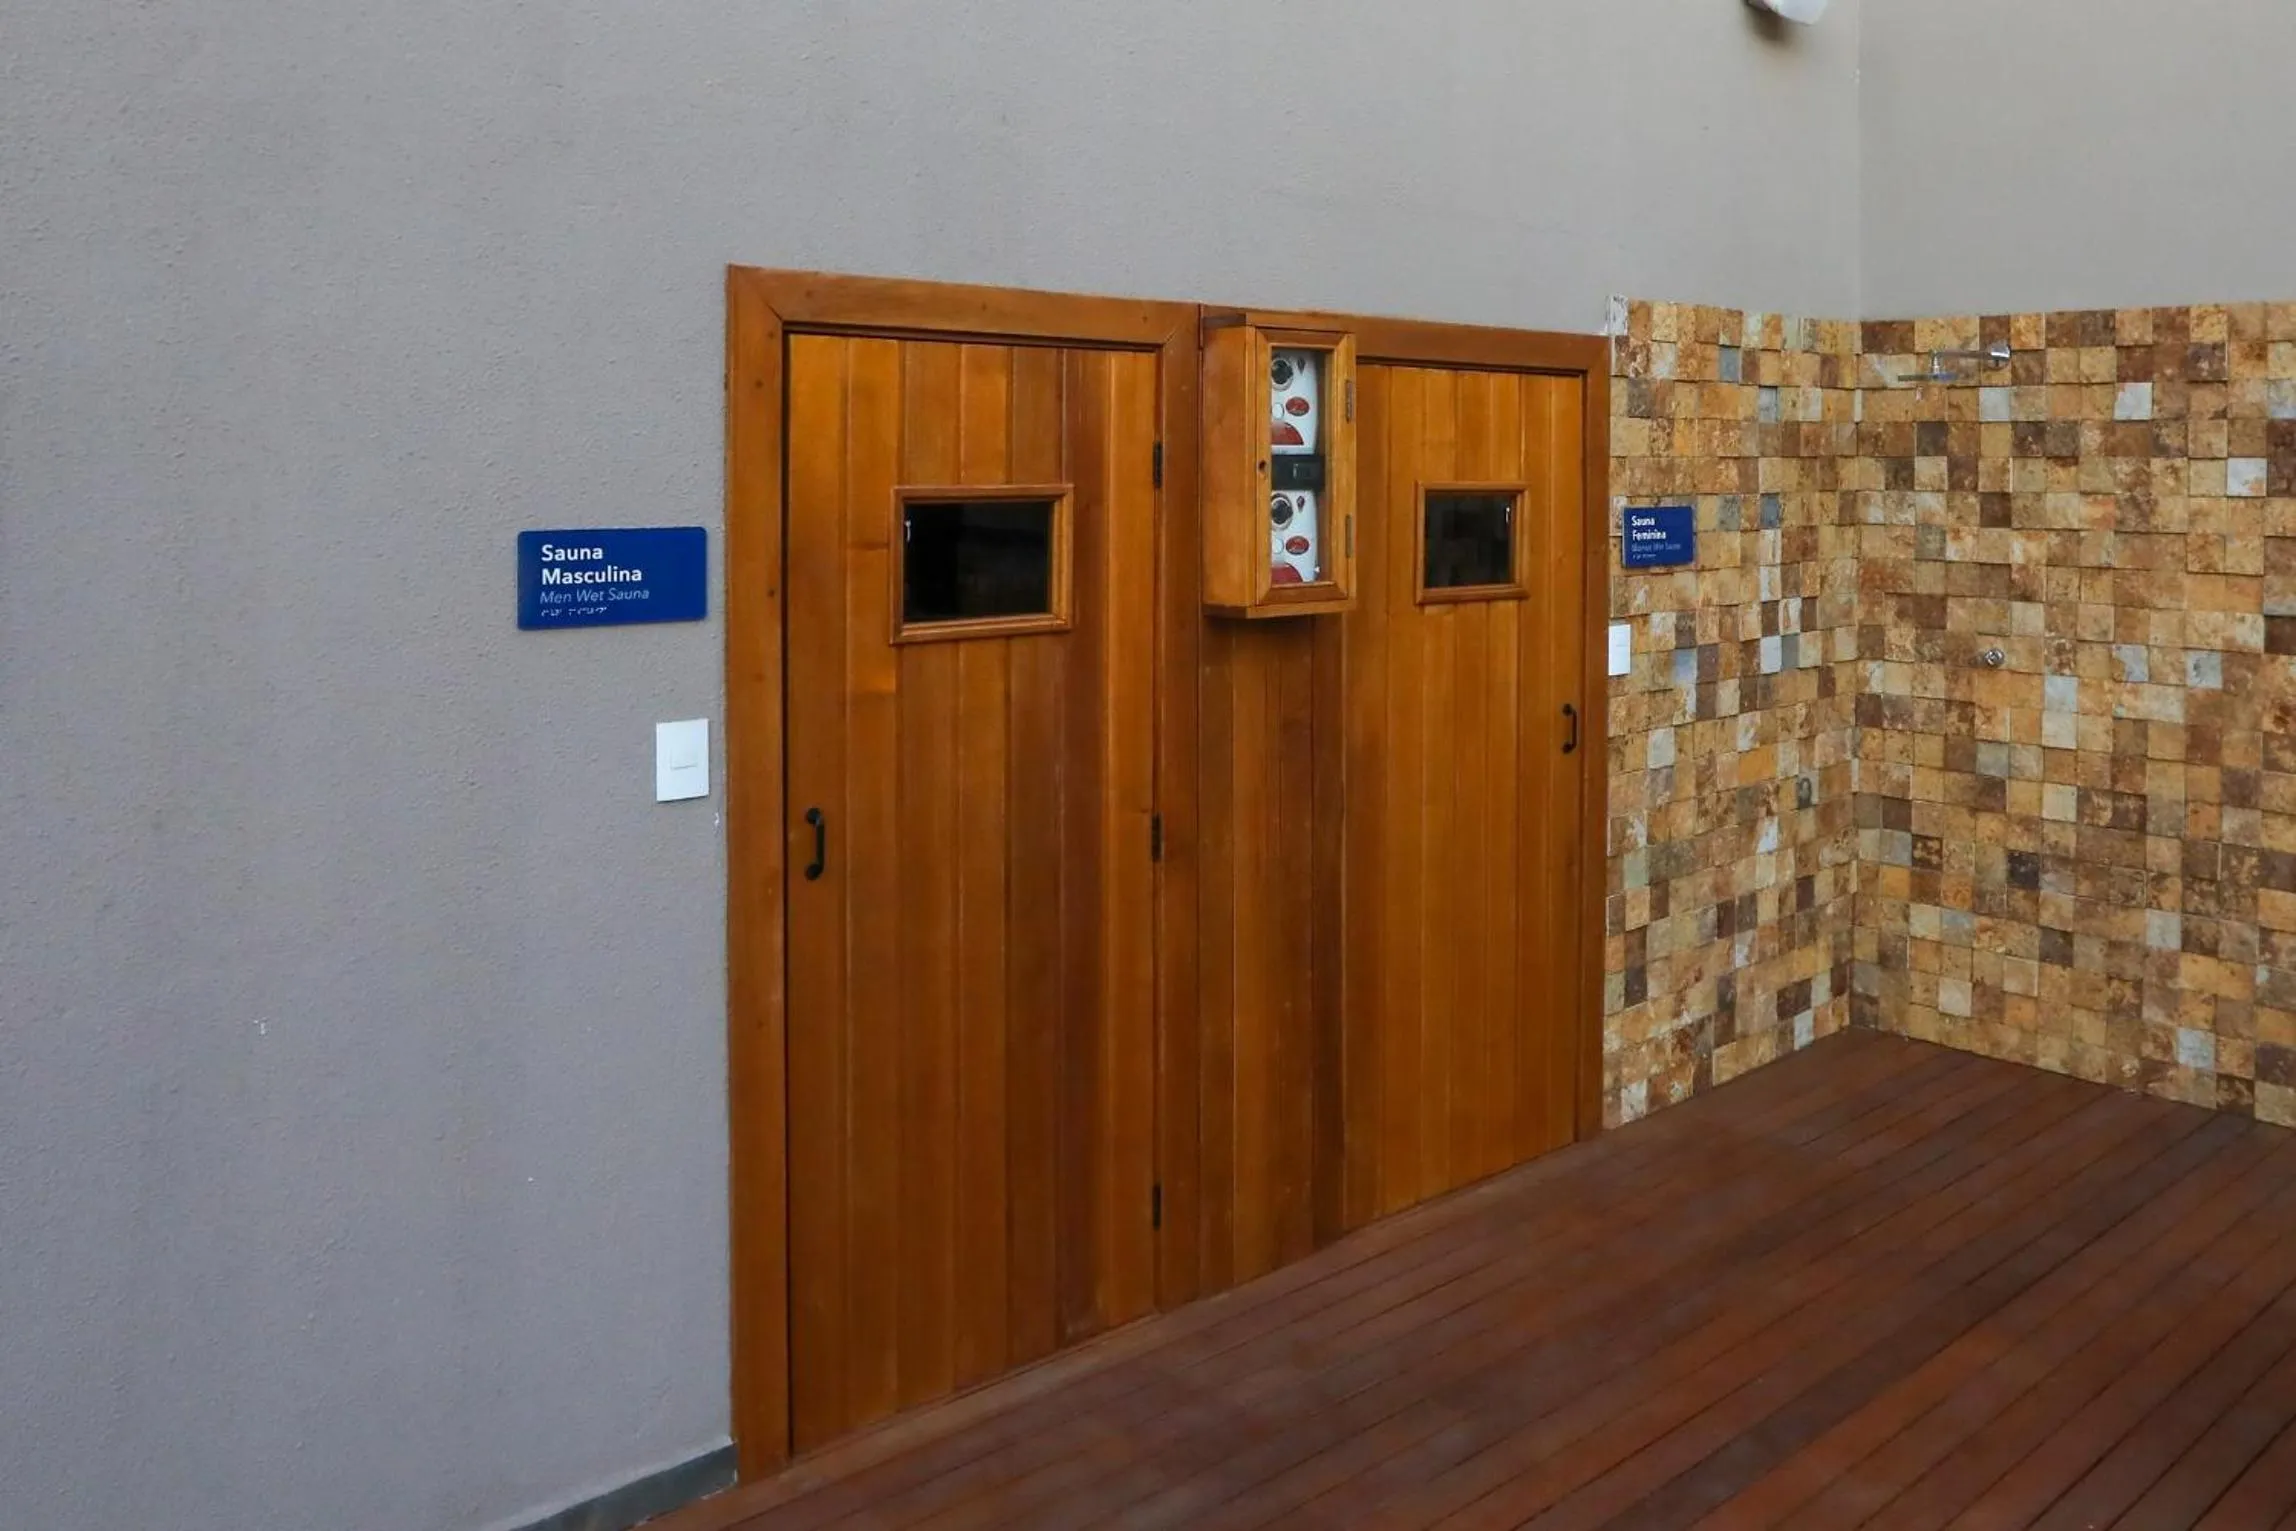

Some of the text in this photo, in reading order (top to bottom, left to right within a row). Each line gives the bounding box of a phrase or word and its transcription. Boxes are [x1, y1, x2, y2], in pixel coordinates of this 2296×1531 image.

[1631, 515, 1655, 526] Sauna
[1632, 529, 1666, 541] Feminina
[541, 544, 603, 561] Sauna
[542, 565, 642, 585] Masculina
[540, 587, 650, 604] Men Wet Sauna
